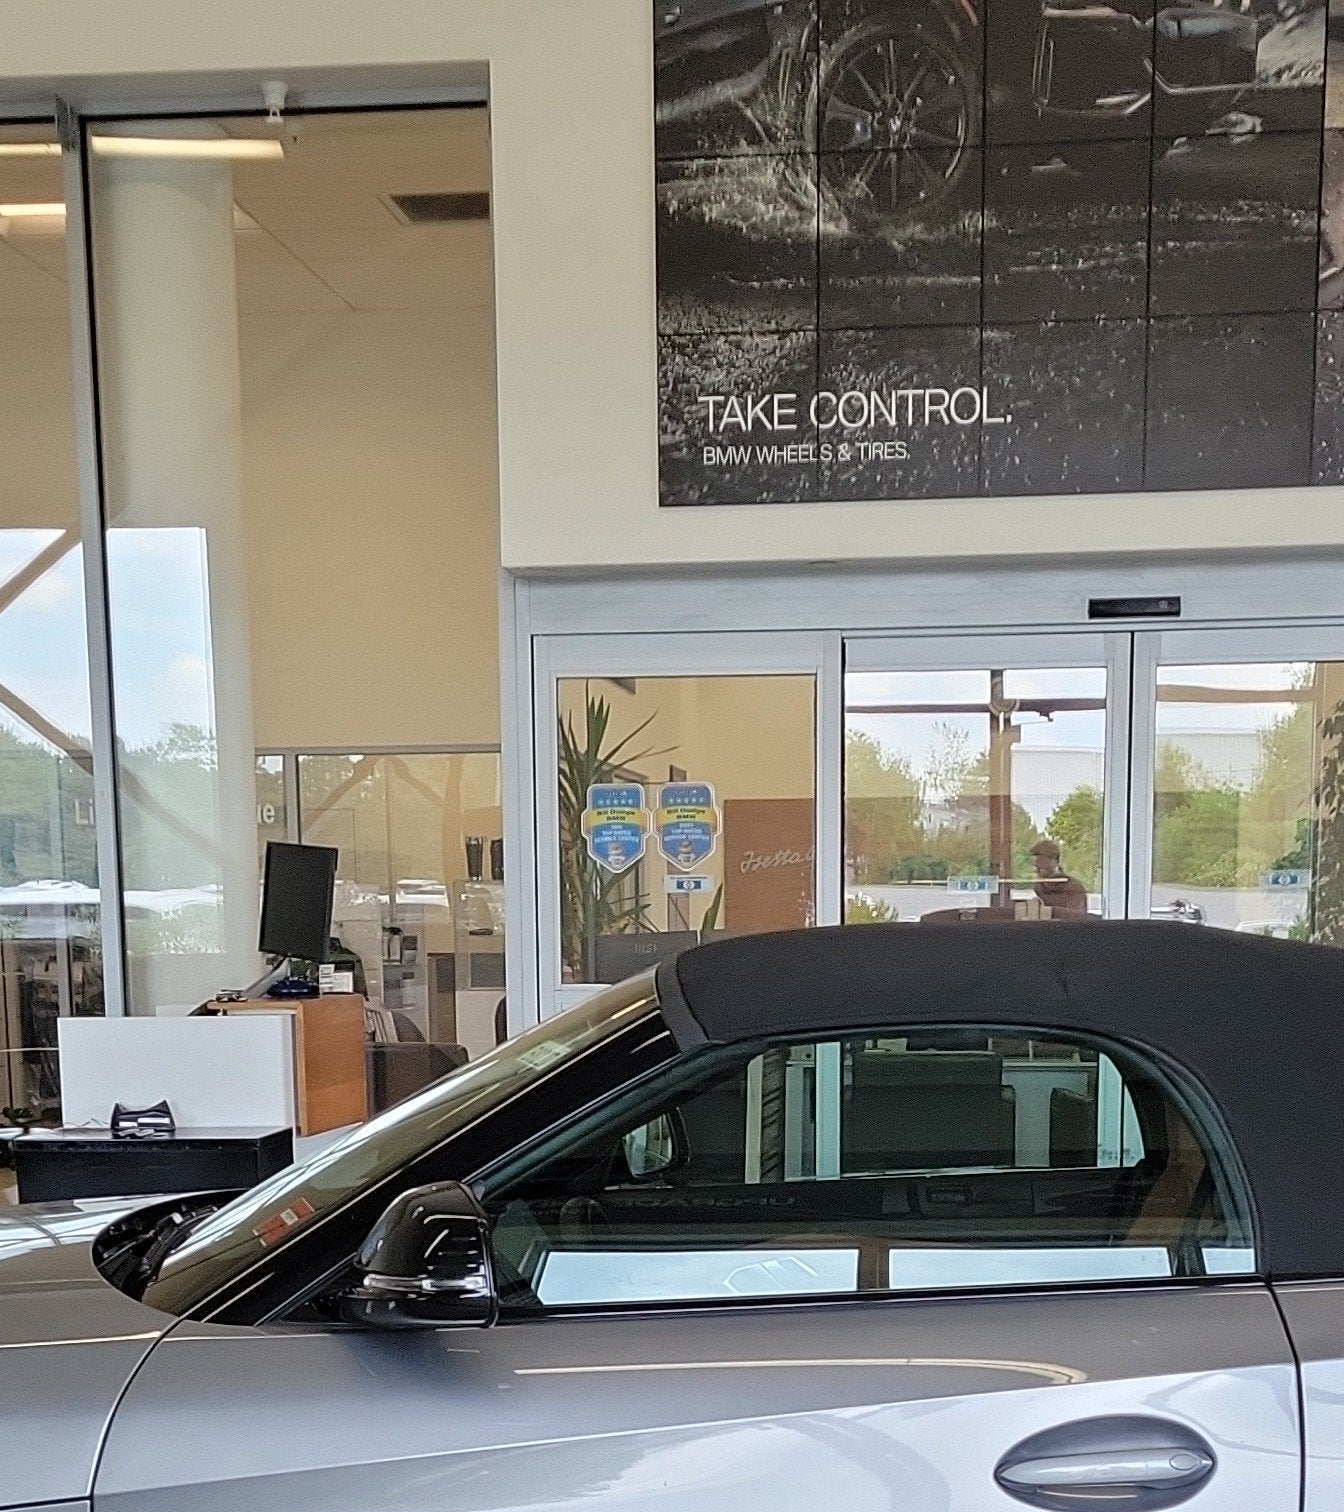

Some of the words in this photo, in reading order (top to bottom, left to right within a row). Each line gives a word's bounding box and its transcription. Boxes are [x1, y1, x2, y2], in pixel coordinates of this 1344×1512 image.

[698, 393, 798, 433] TAKE
[810, 386, 1013, 429] CONTROL.
[703, 446, 752, 466] BMW
[756, 444, 833, 465] WHEELS
[837, 443, 852, 462] &
